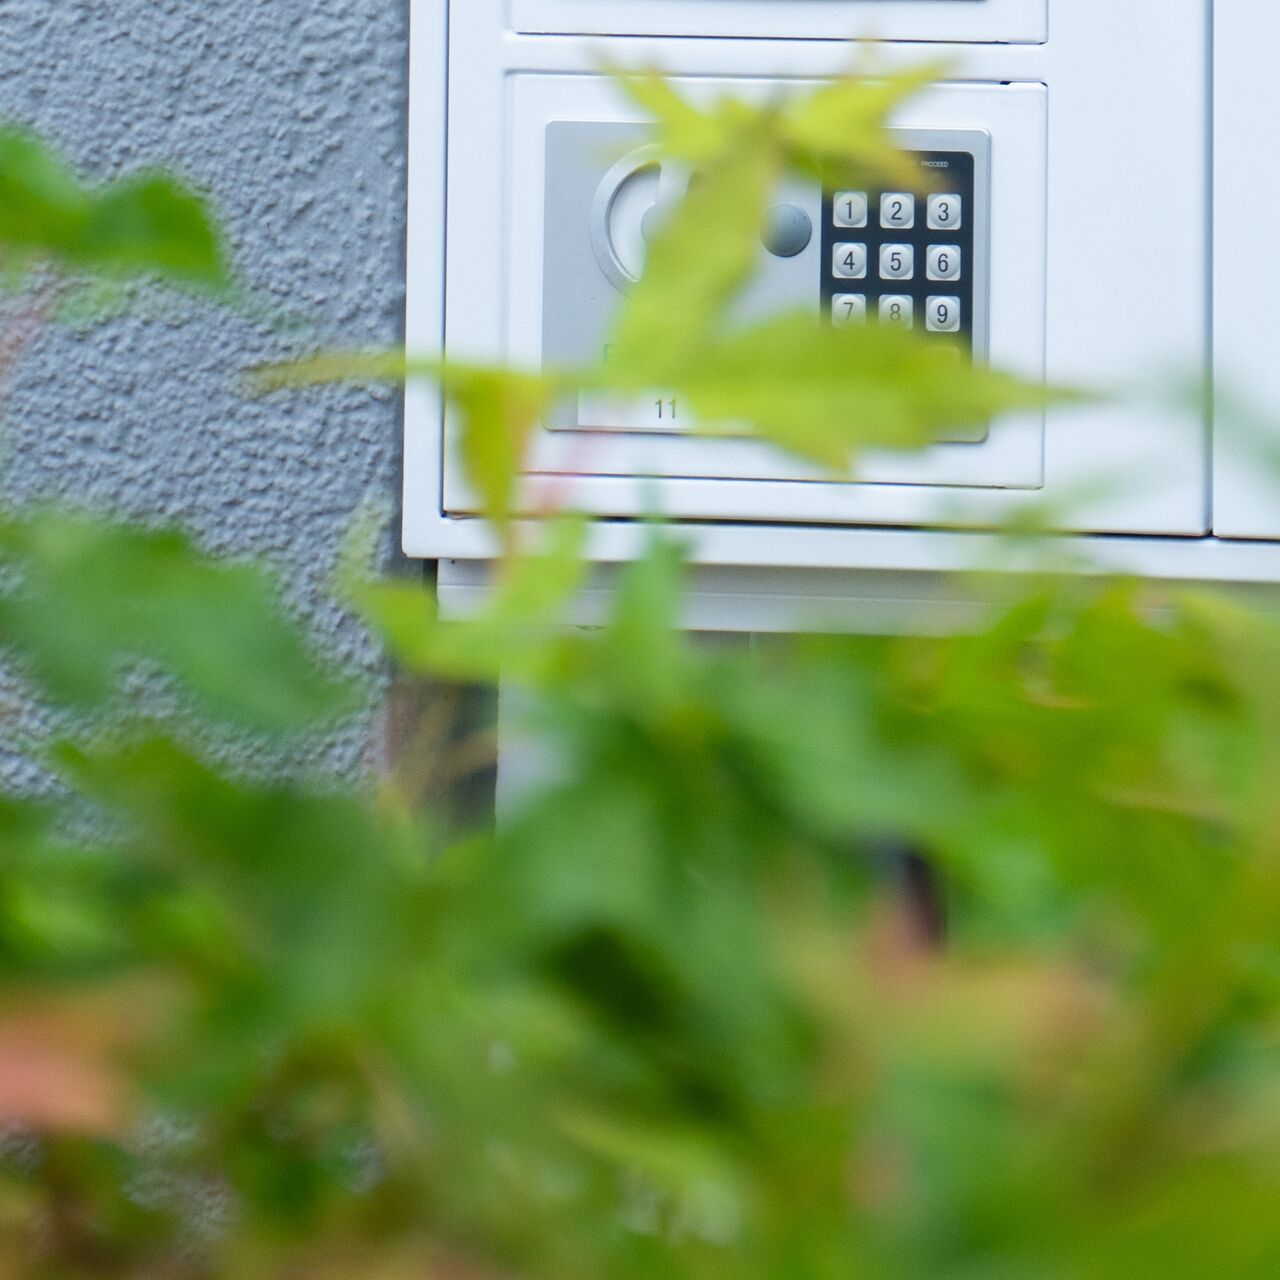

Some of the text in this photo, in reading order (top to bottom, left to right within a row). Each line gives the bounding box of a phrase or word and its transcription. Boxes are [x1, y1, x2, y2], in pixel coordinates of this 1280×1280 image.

[890, 202, 902, 221] 2
[937, 203, 949, 222] 3
[843, 251, 950, 274] 4 5 6
[655, 399, 677, 419] 11
